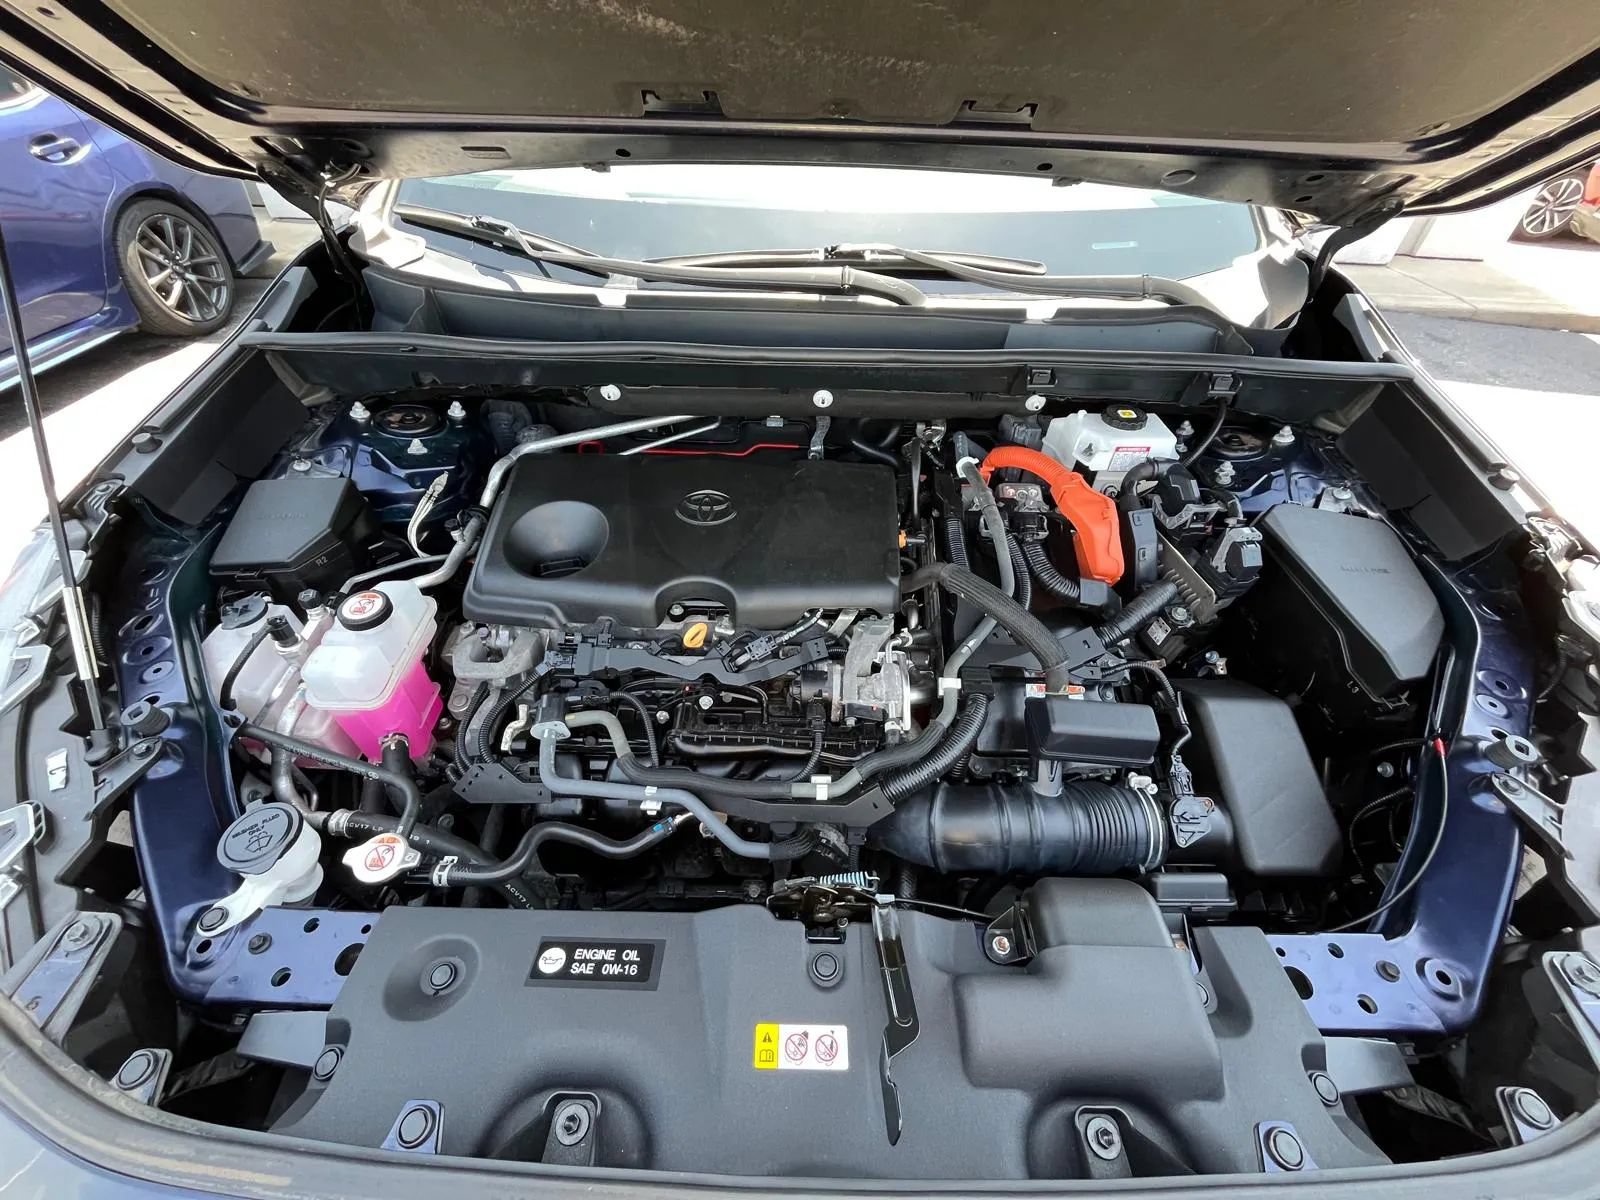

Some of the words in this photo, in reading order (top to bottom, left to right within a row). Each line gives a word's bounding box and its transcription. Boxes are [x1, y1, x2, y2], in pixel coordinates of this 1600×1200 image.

[315, 555, 328, 567] R2
[1346, 680, 1360, 694] L3
[231, 823, 259, 839] WASHER
[262, 813, 280, 824] FLUID
[248, 825, 265, 836] ONLY
[504, 883, 527, 903] ACV17
[574, 948, 617, 960] ENGINE
[622, 949, 641, 961] OIL
[569, 962, 595, 974] SAE
[601, 963, 638, 975] 0W-16
